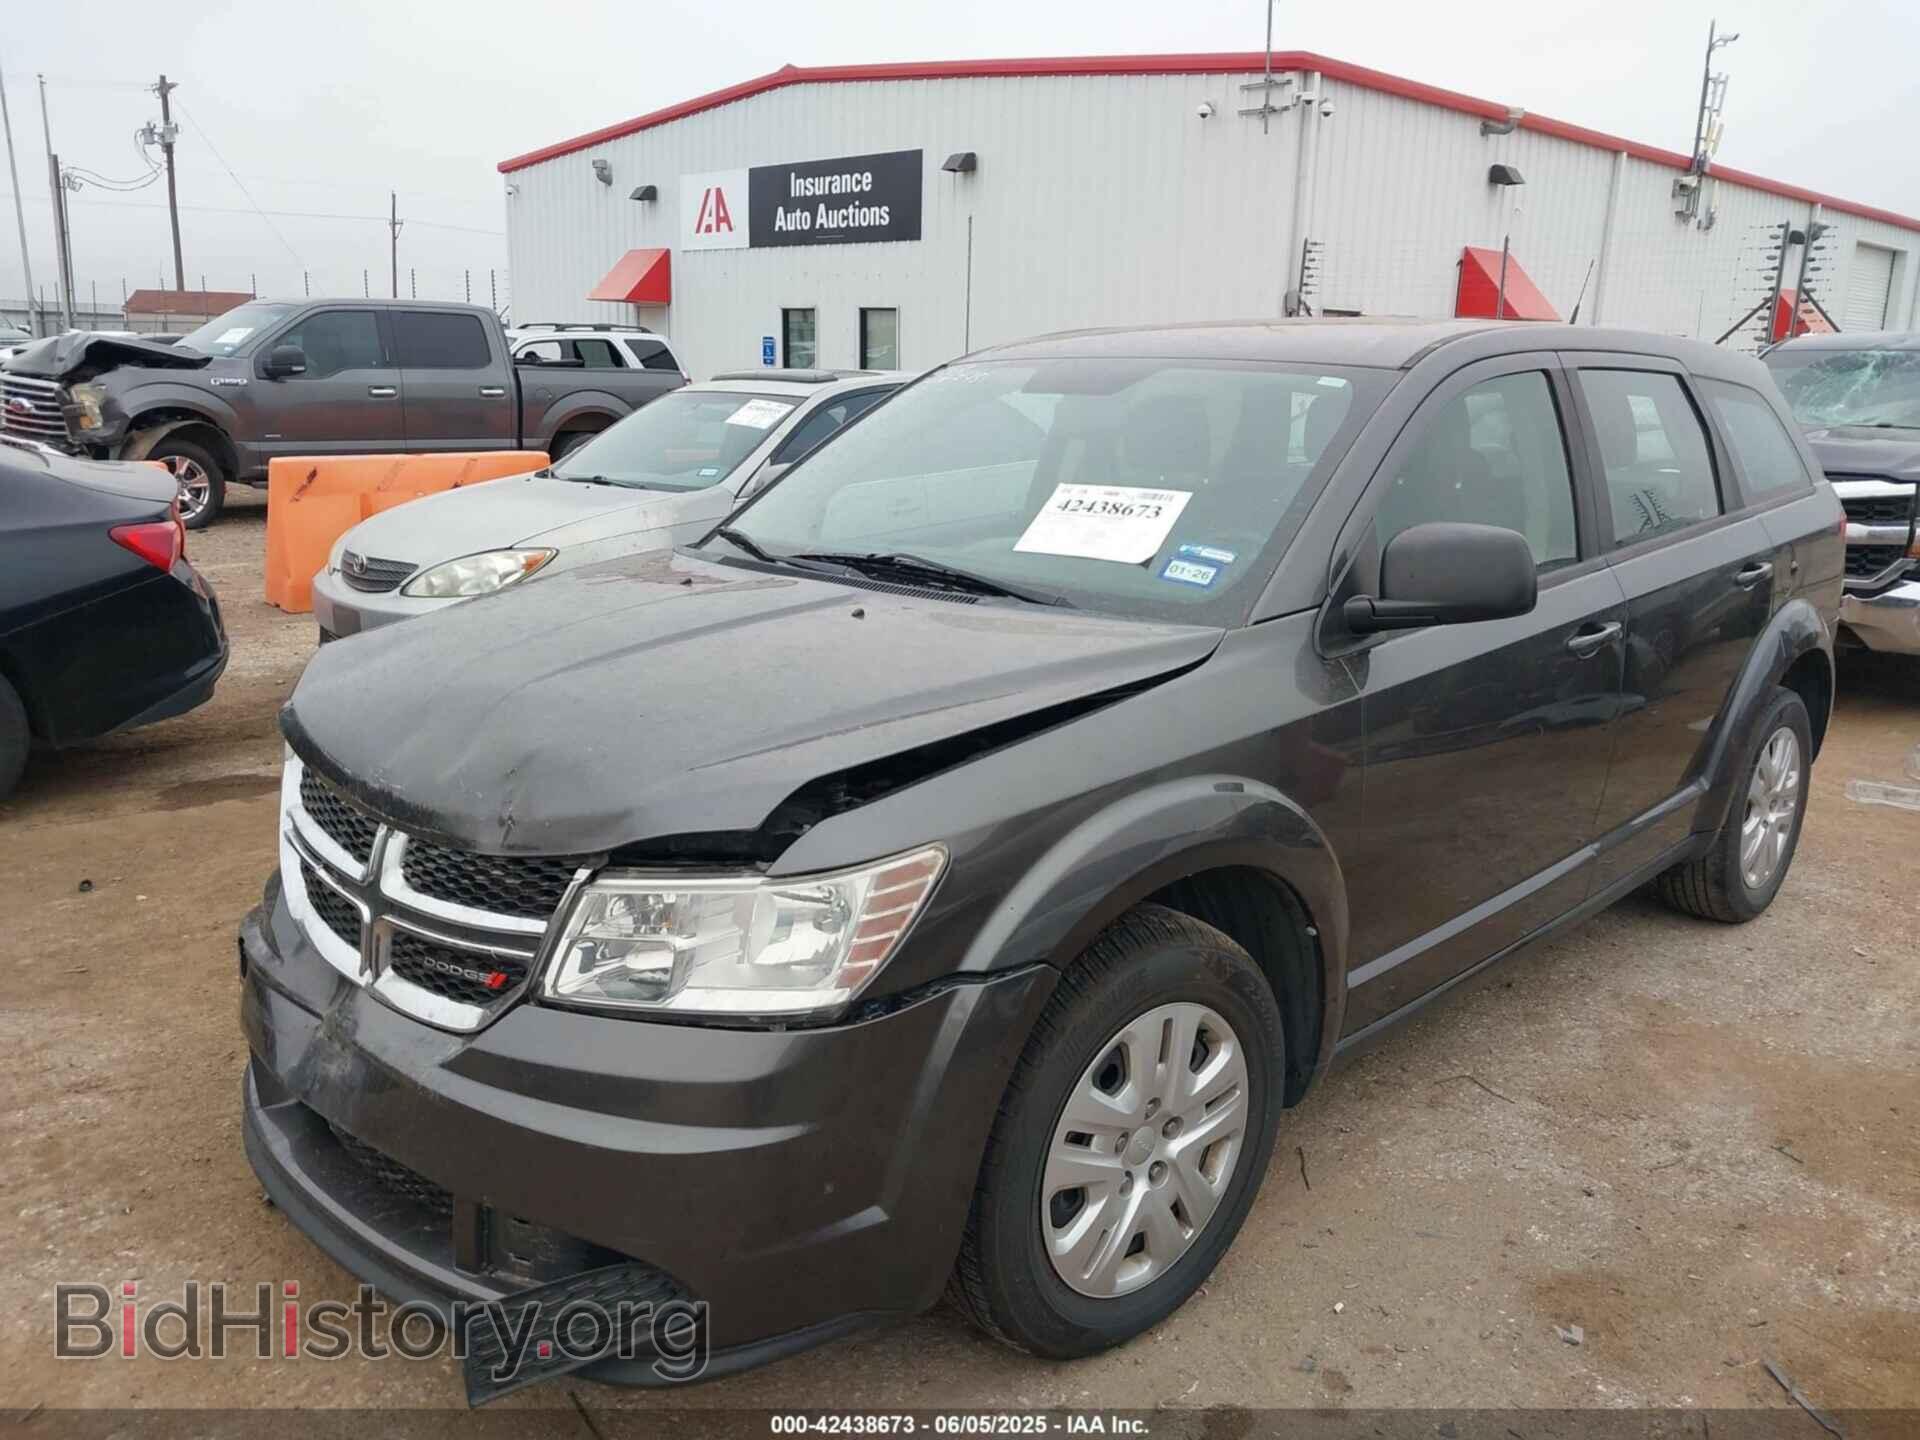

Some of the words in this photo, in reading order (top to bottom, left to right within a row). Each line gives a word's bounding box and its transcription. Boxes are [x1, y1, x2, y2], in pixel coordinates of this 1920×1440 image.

[790, 171, 873, 197] Insurance
[774, 206, 811, 232] Auto
[815, 200, 890, 229] Auctions
[1057, 499, 1163, 519] 42438673
[424, 957, 491, 983] DODGE
